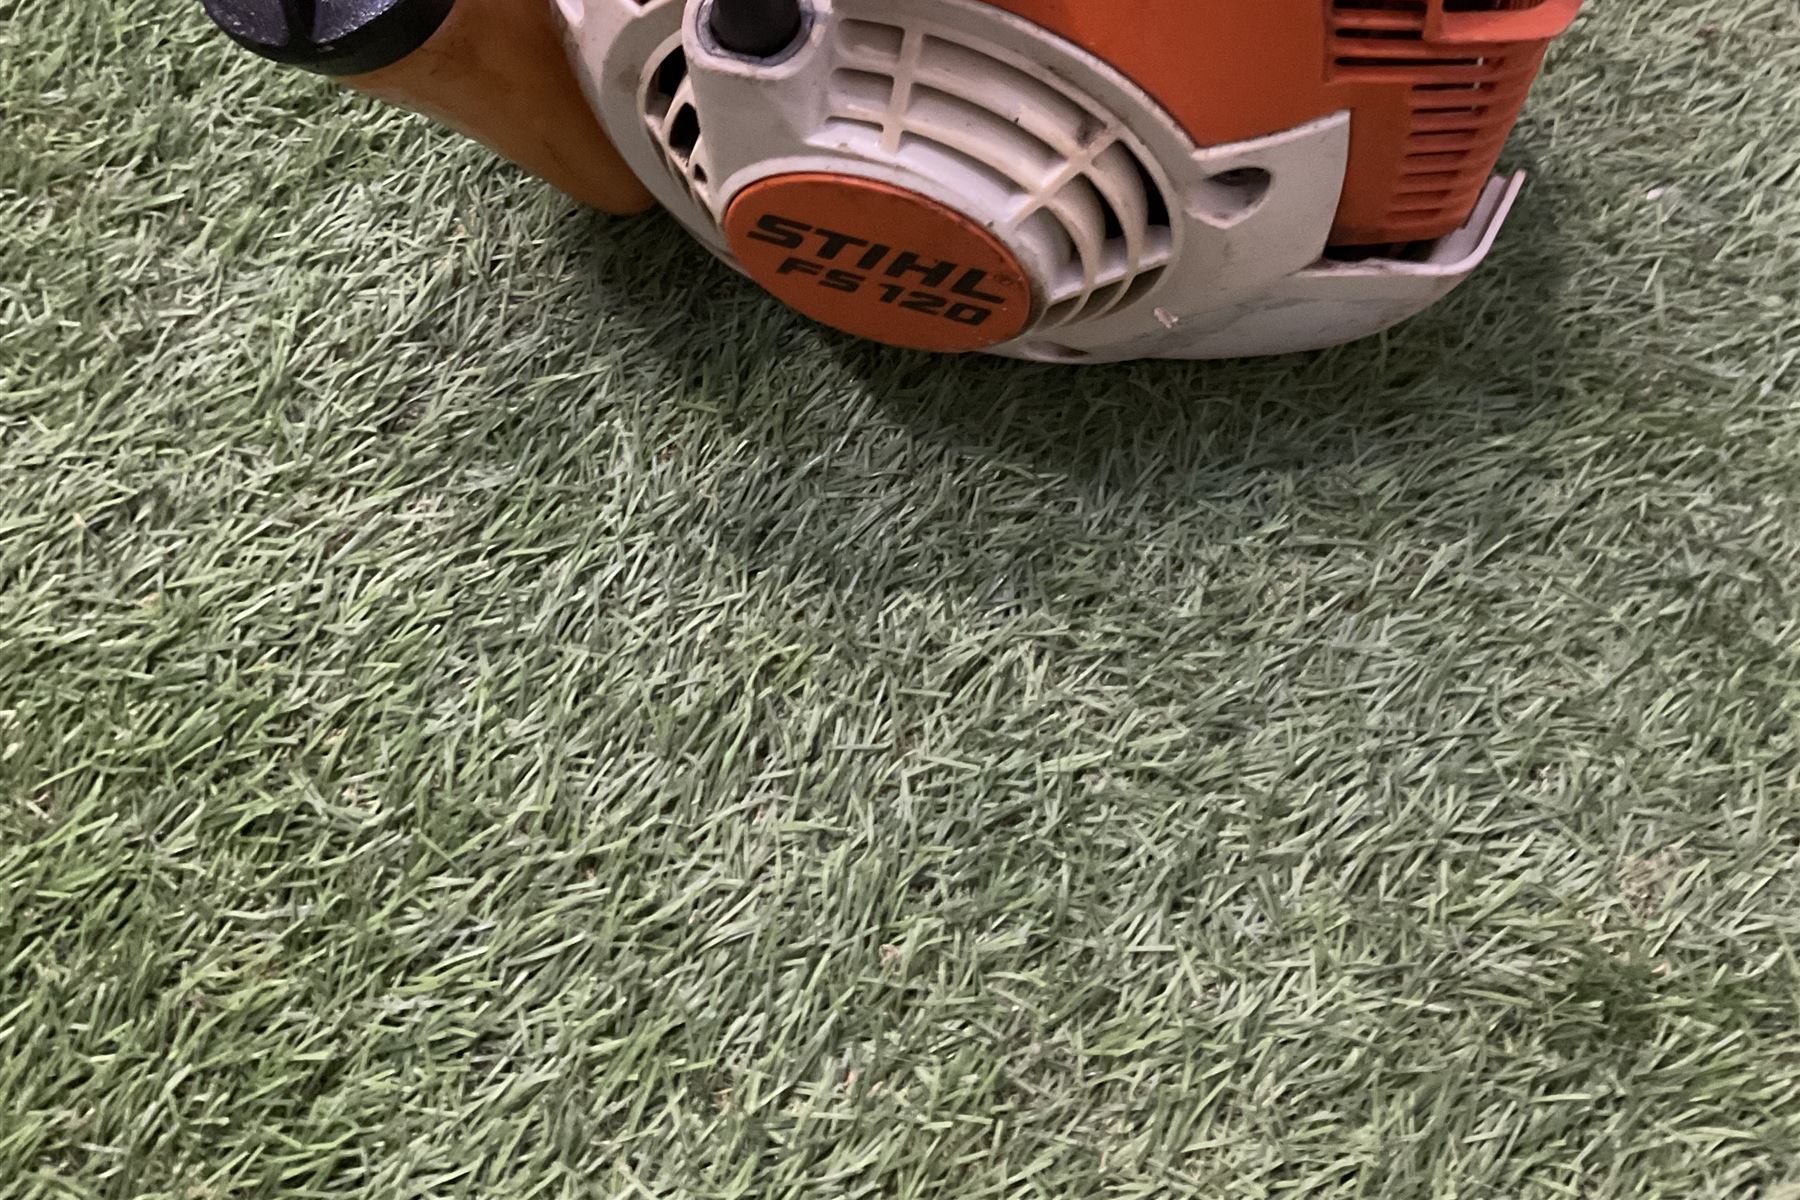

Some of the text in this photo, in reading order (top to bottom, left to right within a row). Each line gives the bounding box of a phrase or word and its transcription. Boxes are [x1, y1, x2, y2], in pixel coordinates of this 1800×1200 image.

[746, 213, 1006, 305] STIHL
[776, 256, 992, 326] FS 120
